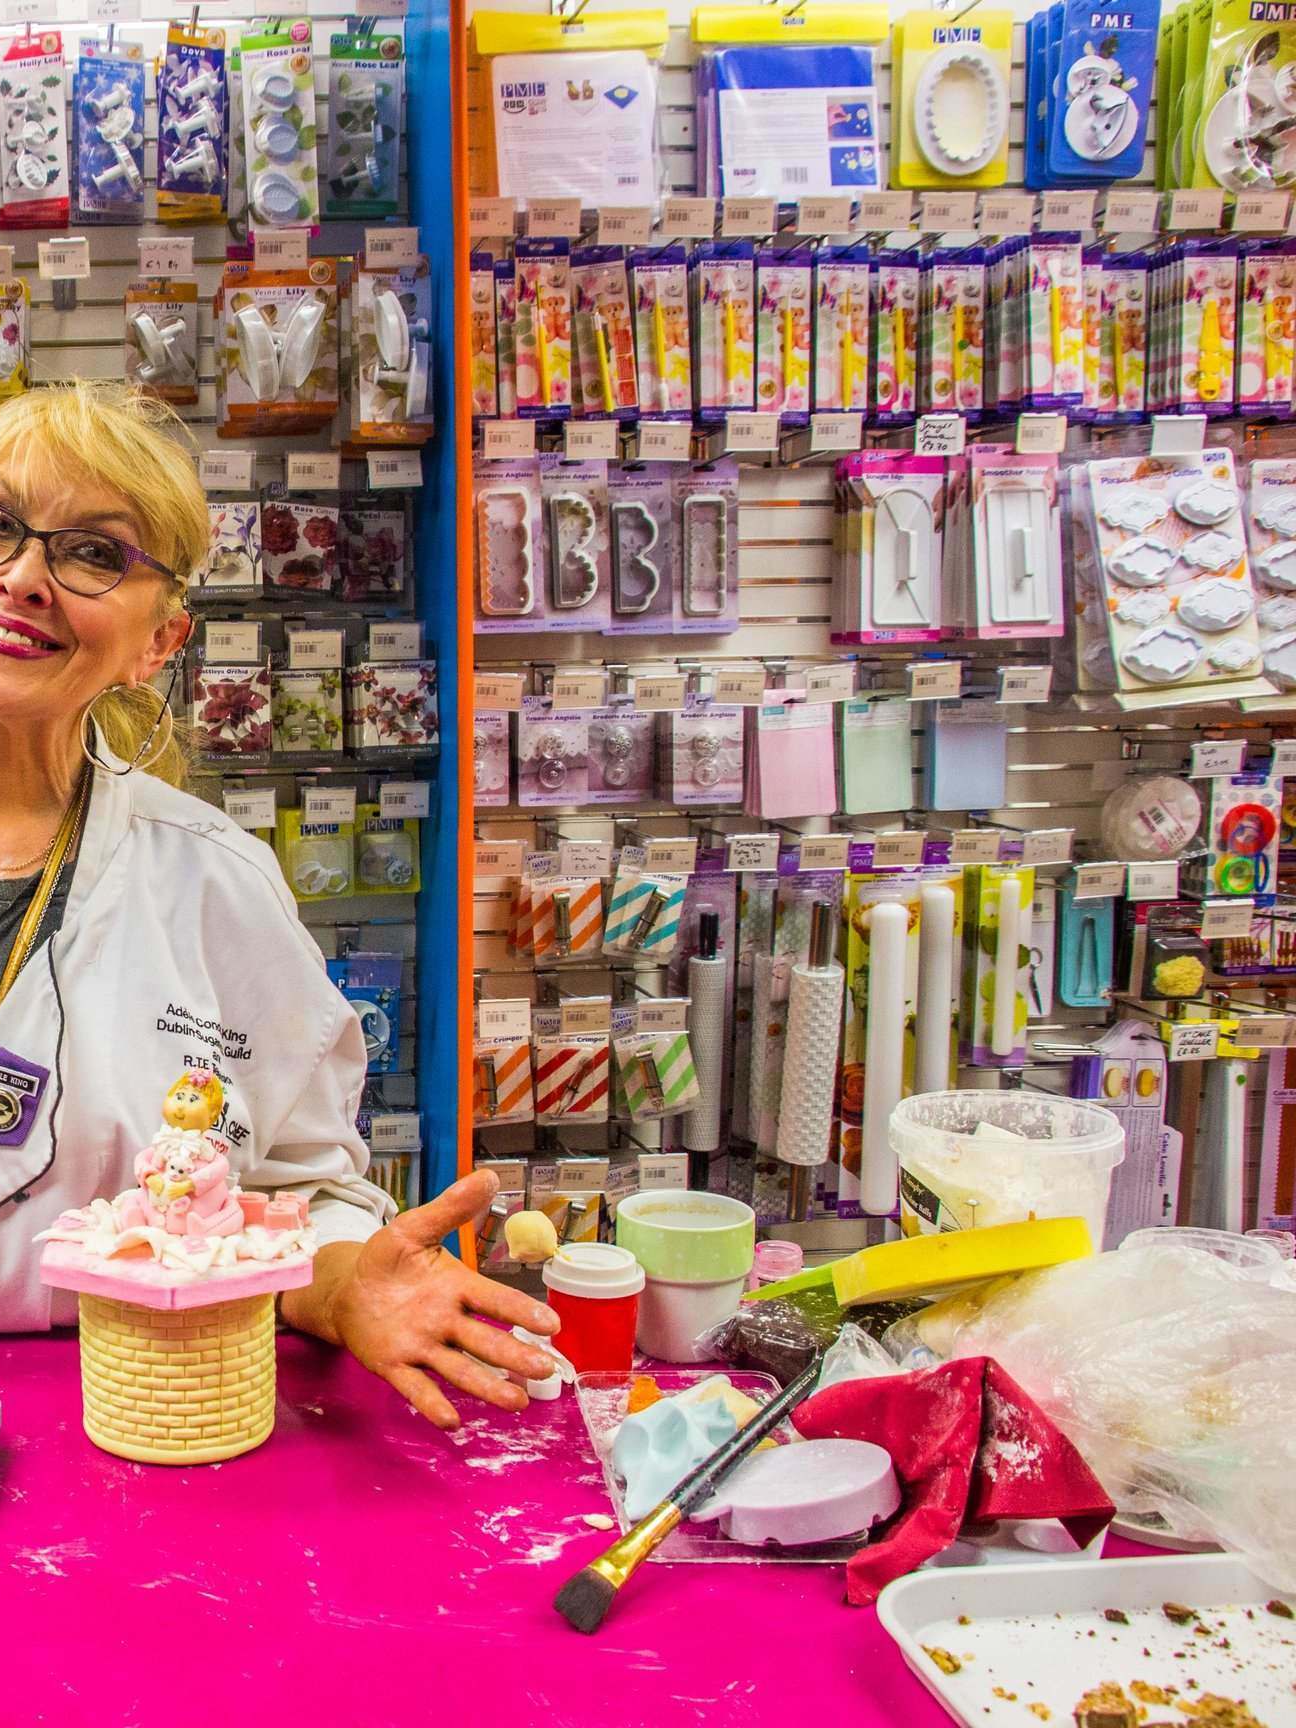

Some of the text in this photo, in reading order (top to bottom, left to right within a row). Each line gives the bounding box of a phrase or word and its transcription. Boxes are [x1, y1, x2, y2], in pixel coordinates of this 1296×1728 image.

[1250, 2, 1296, 21] PME
[1091, 13, 1133, 29] PME
[933, 28, 982, 44] PME
[266, 49, 288, 57] Rose
[291, 46, 310, 55] Leaf
[44, 56, 62, 65] Leaf
[379, 61, 399, 69] Leaf
[501, 82, 547, 98] PME
[518, 257, 554, 265] Modelling
[254, 287, 306, 297] Veined Lily
[166, 302, 184, 312] Lily
[505, 471, 534, 479] Anglaise
[574, 473, 600, 481] Anglaise
[981, 469, 1023, 477] Smoother
[301, 823, 339, 836] PME
[366, 819, 403, 832] PME
[157, 1018, 195, 1038] Dublin
[224, 1046, 252, 1060] Guild
[221, 1028, 248, 1044] King
[493, 1035, 523, 1043] Crimper
[10, 1076, 29, 1089] KING
[1158, 1132, 1170, 1187] Cake Leveller
